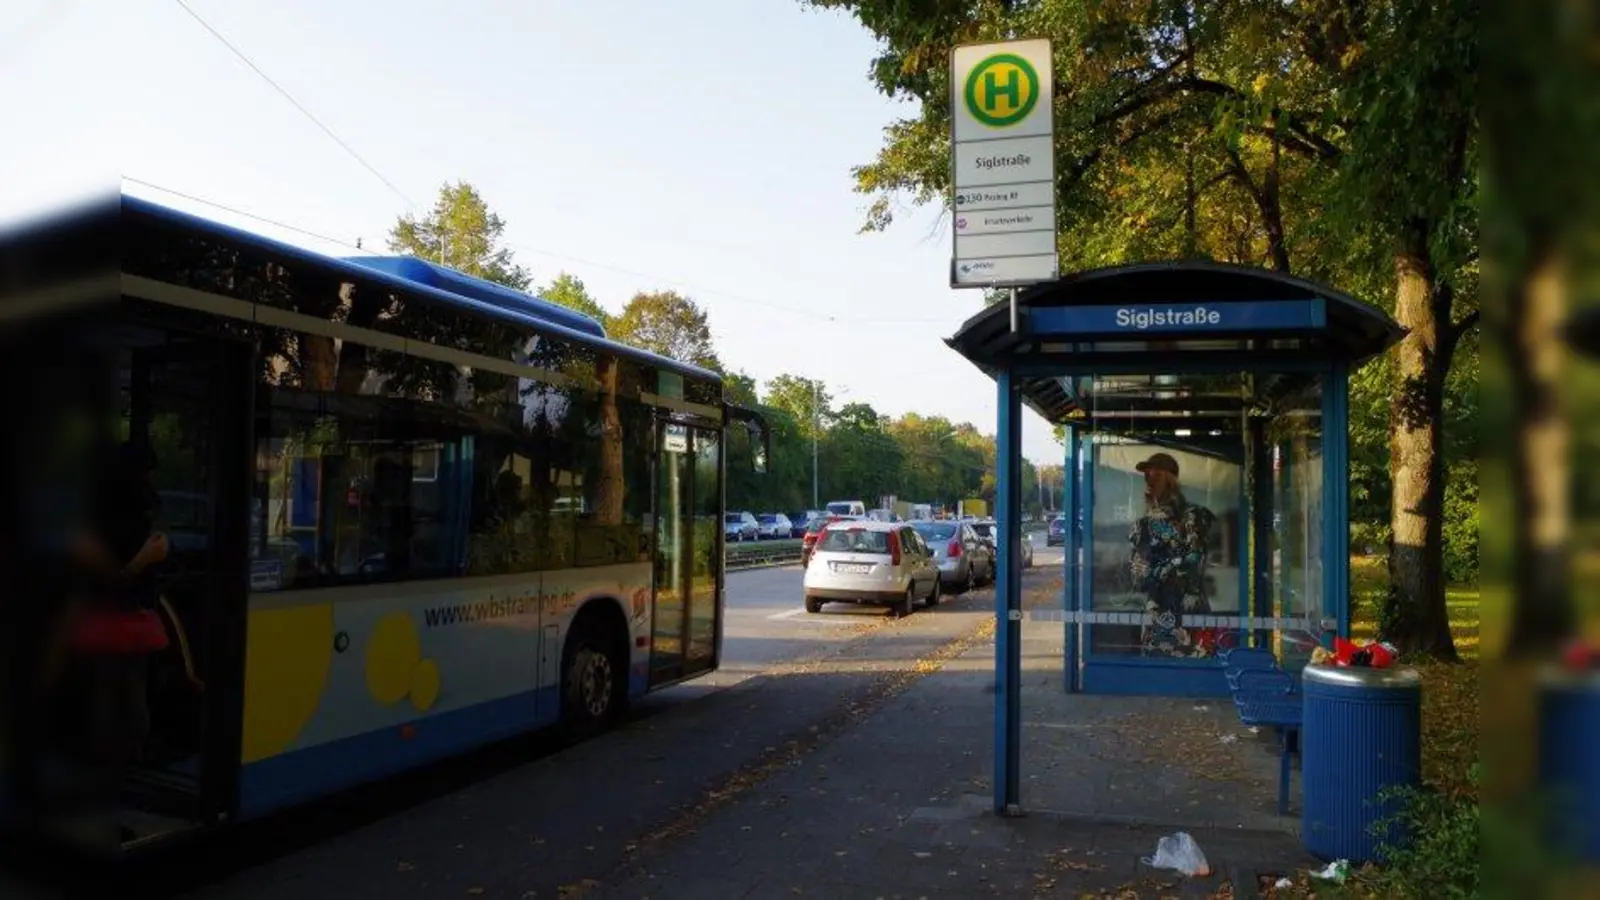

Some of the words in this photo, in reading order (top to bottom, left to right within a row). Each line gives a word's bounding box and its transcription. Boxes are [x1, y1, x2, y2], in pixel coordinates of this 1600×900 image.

[984, 69, 1020, 112] H
[975, 153, 1032, 170] Siglstraße
[1115, 306, 1221, 330] Siglstraße
